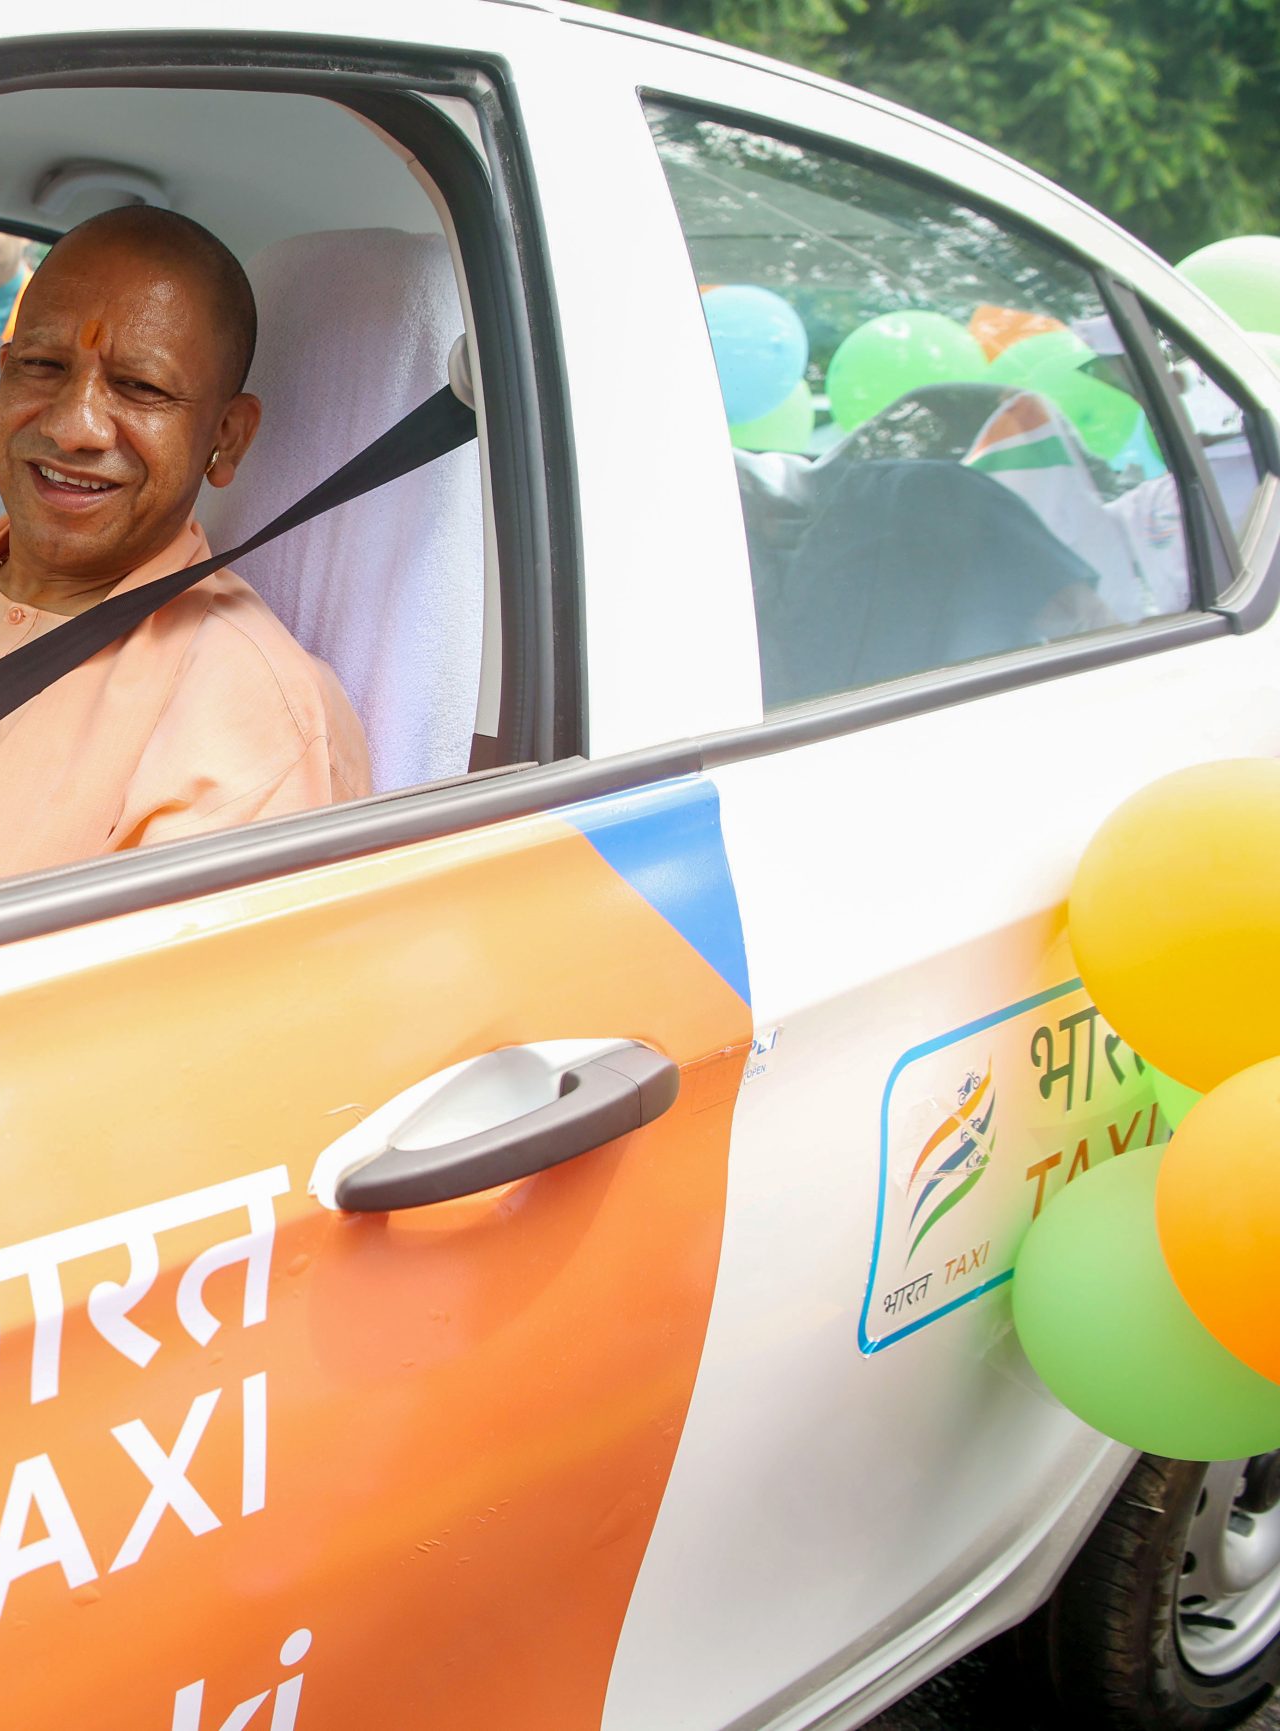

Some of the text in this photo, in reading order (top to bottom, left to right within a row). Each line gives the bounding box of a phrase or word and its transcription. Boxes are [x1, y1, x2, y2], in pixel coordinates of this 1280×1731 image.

[1031, 1005, 1146, 1112] भार
[883, 1240, 990, 1315] भारत TAXI
